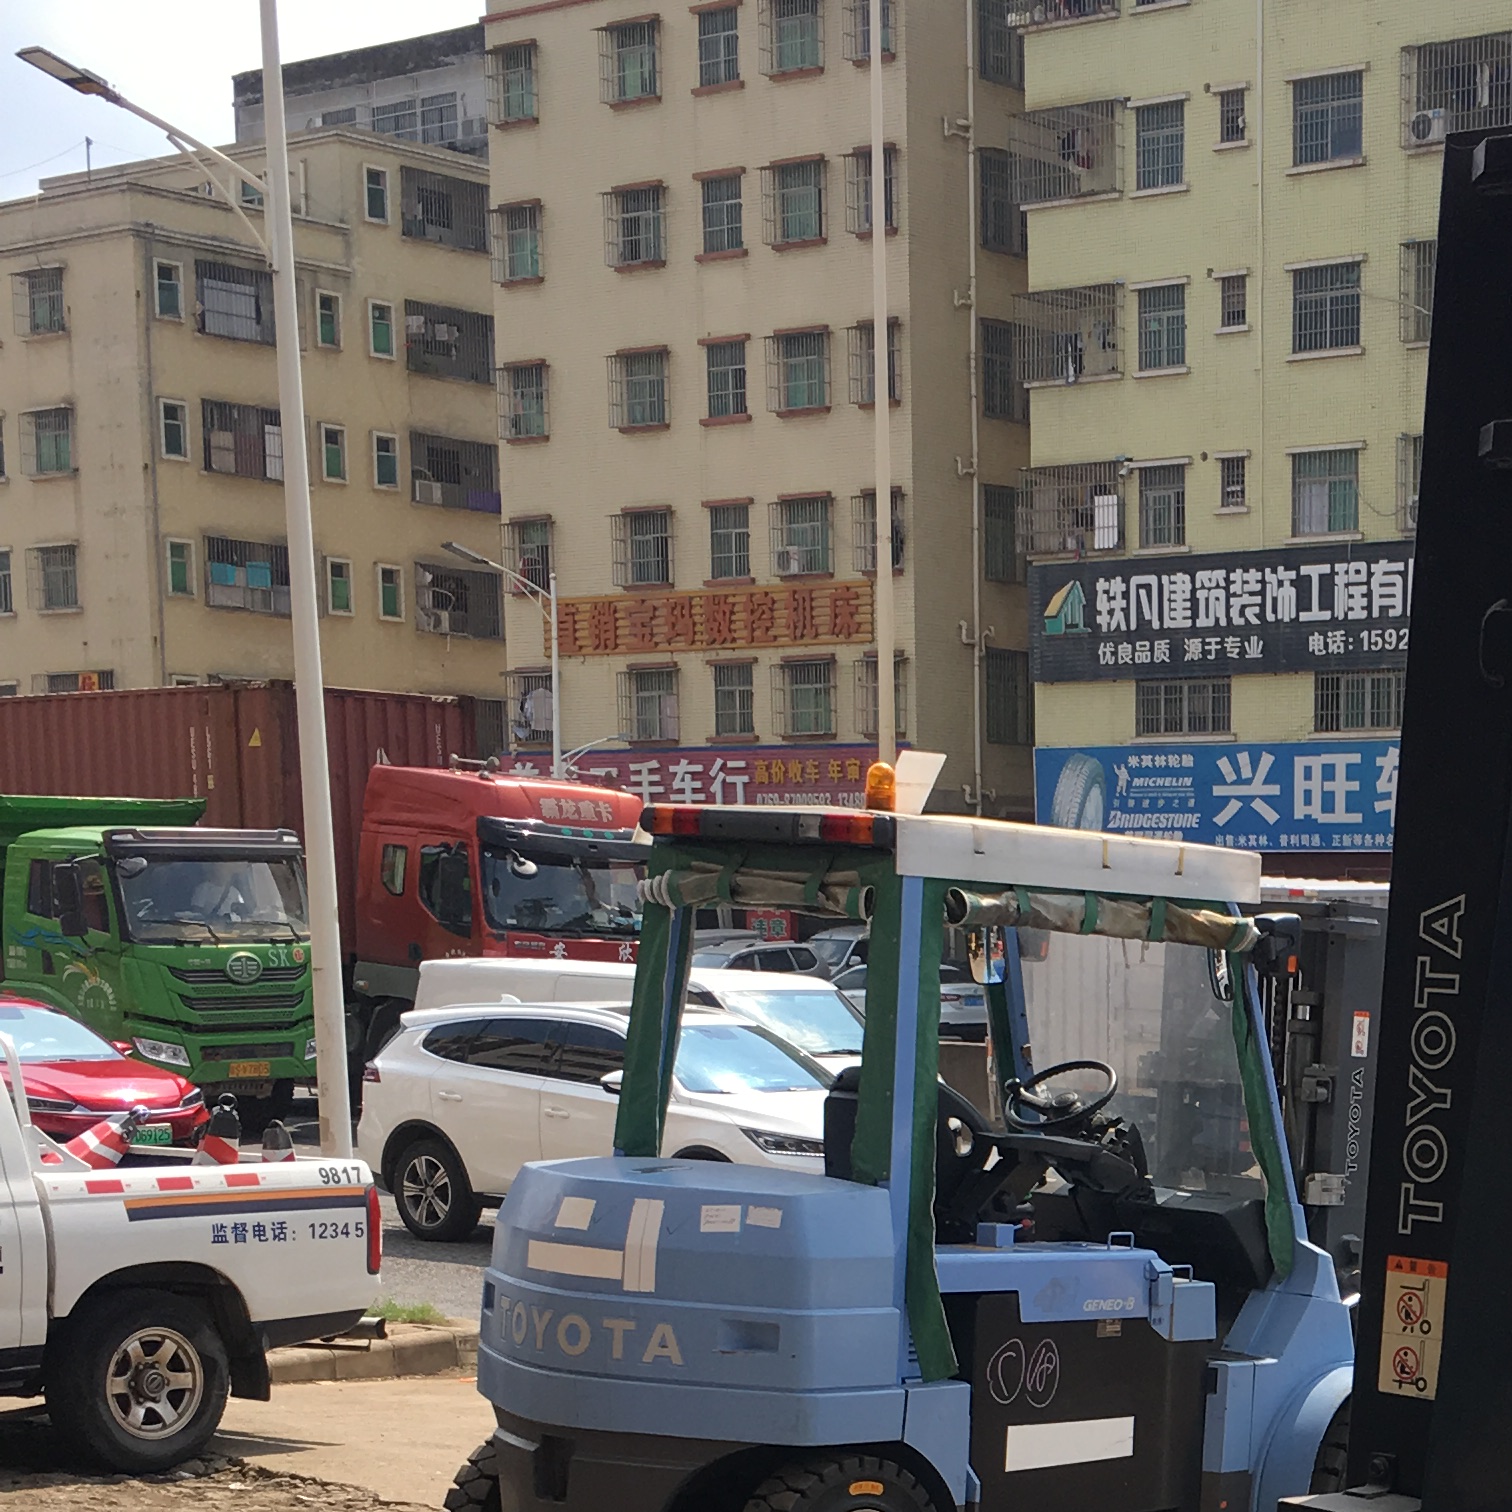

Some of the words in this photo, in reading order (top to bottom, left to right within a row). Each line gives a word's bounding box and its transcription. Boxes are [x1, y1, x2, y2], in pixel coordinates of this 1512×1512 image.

[1096, 558, 1413, 633] 轶凡建筑装饰工程有
[556, 586, 861, 653] 直销宝玛数控机床
[1098, 639, 1171, 666] 优良品质
[1184, 635, 1264, 662] 源于专业
[754, 758, 820, 785] 高价收车
[1132, 776, 1194, 787] MICHELIN
[1107, 810, 1201, 829] BRIDGESTONE
[1399, 893, 1466, 1235] TOYOTA
[1345, 1067, 1364, 1175] TOYOTA
[318, 1167, 362, 1185] 9817
[308, 1222, 365, 1240] 12345
[500, 1294, 684, 1366] TOYOTA
